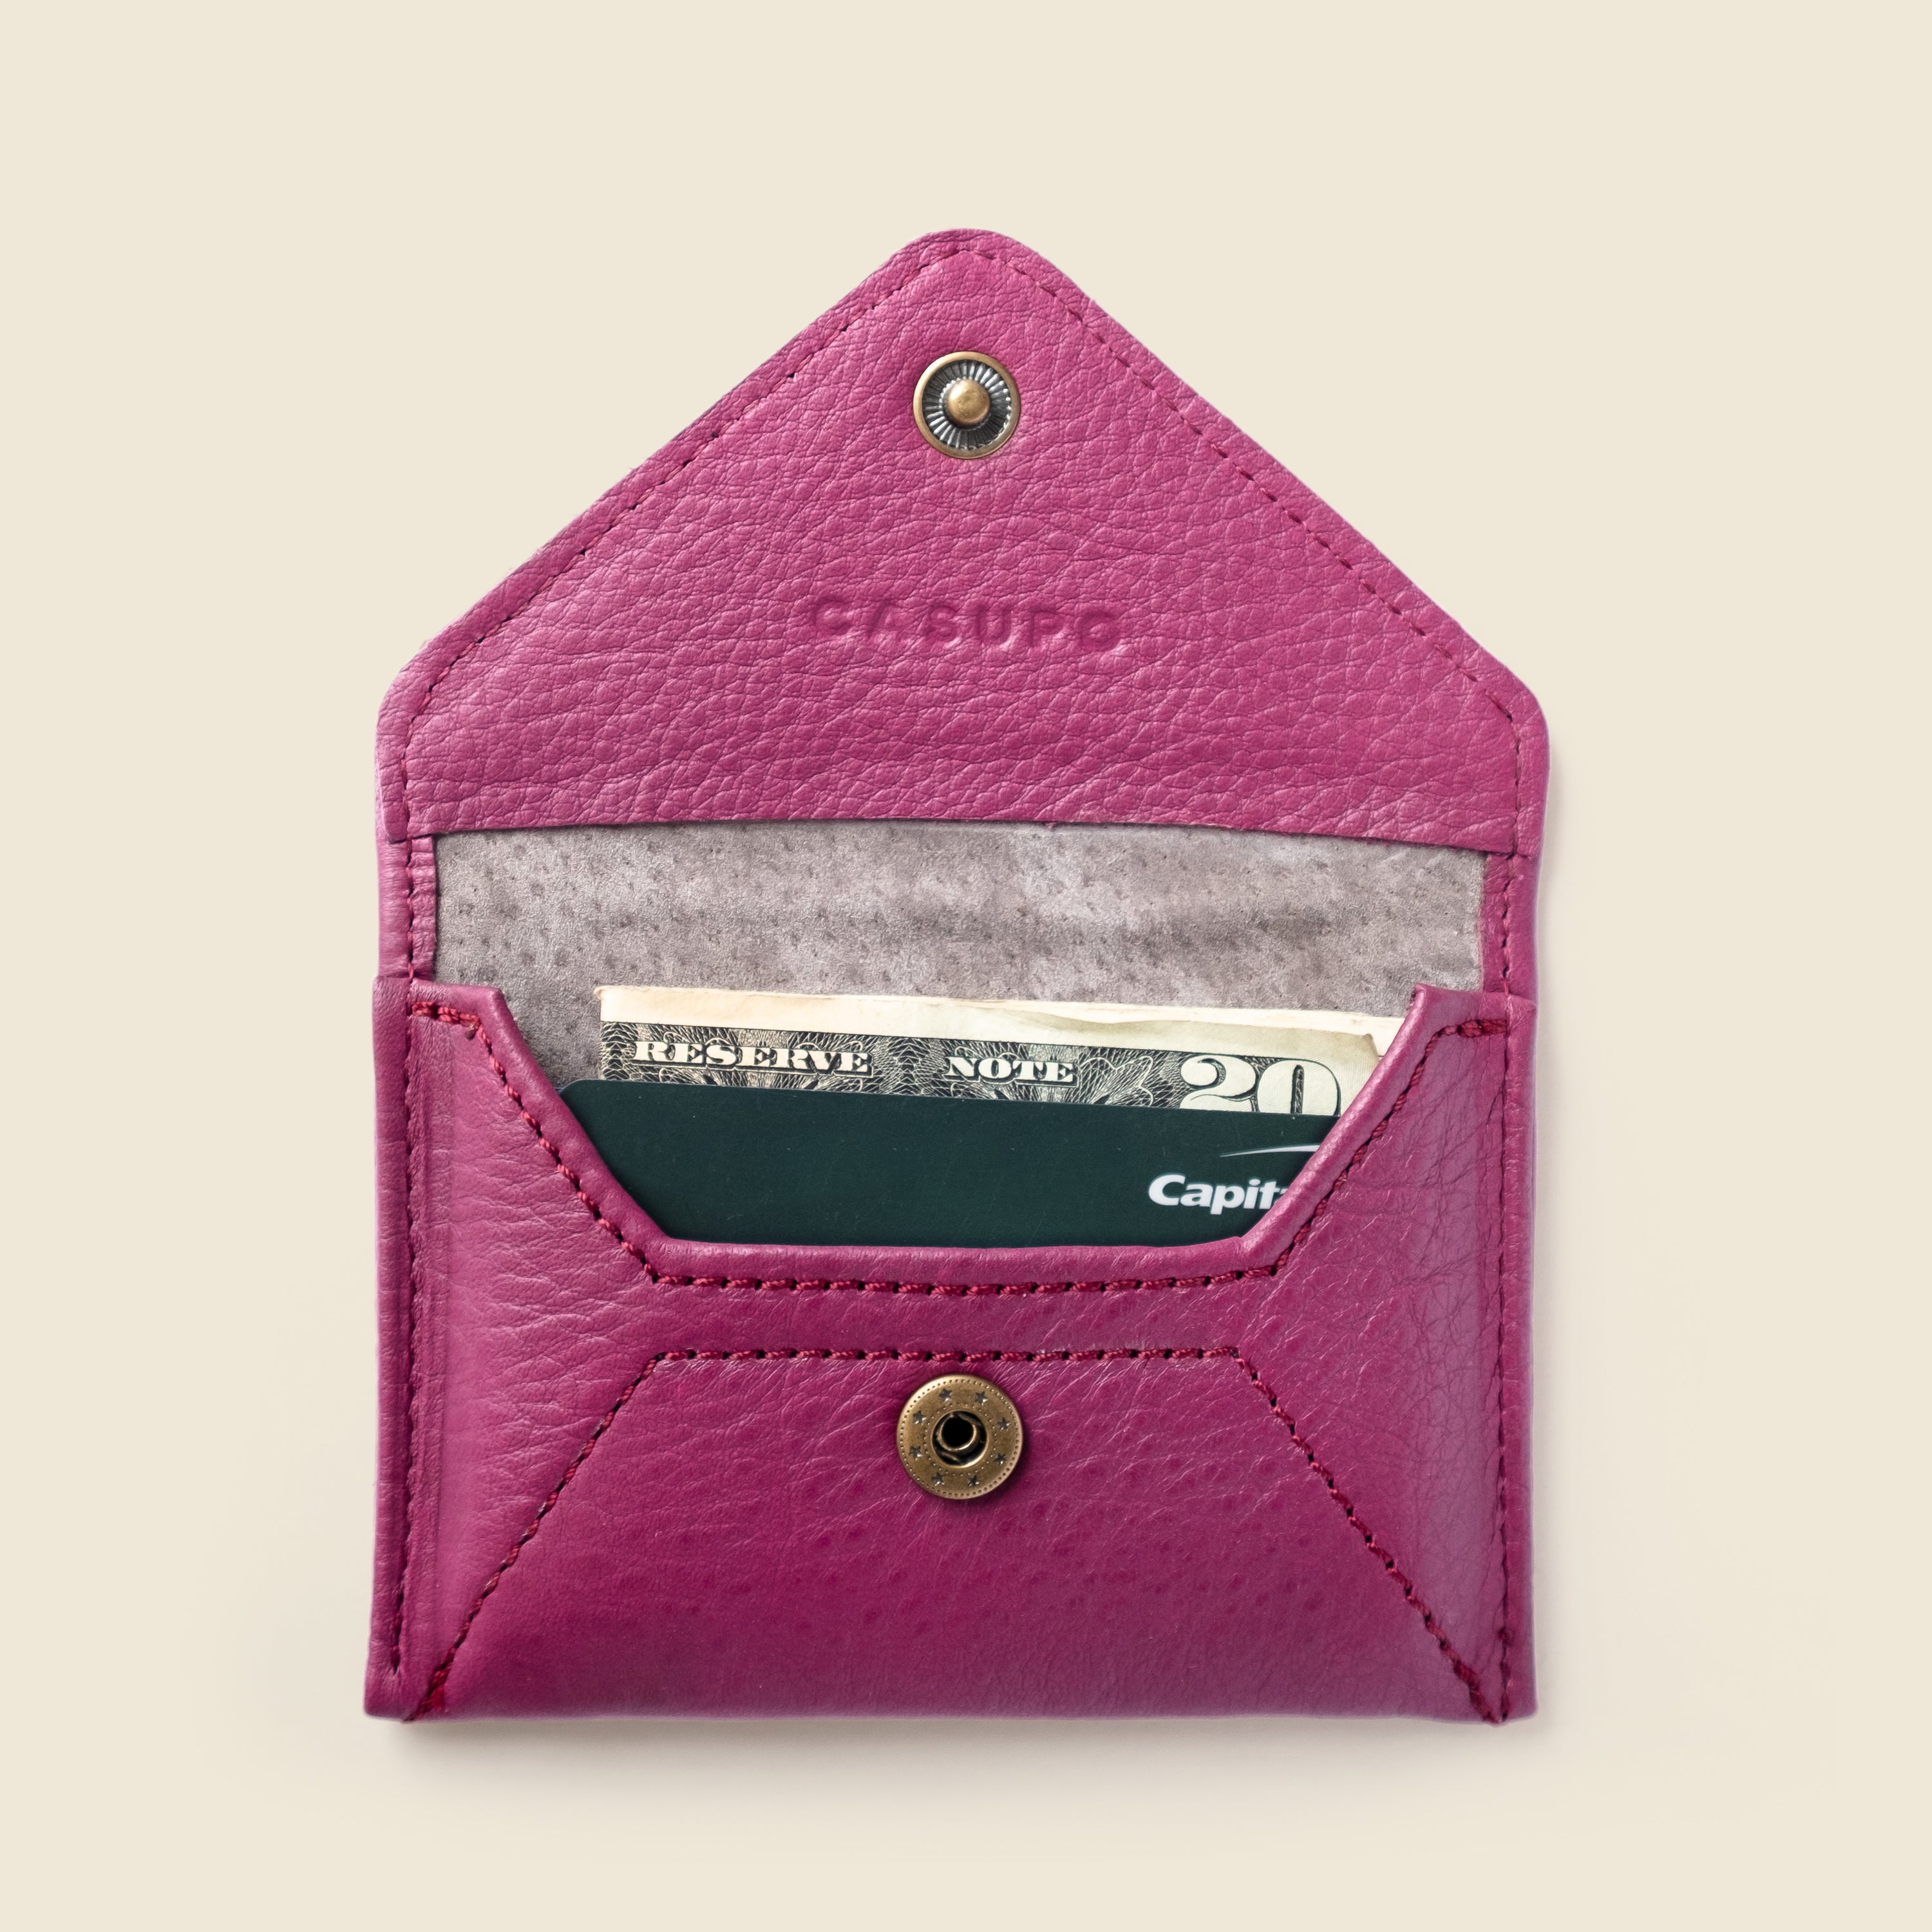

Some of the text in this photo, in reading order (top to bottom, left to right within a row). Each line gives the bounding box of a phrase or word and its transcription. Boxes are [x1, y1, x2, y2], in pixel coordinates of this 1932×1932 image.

[633, 1040, 1079, 1086] RESERVE NOTE
[1179, 1054, 1341, 1117] 20
[1148, 1173, 1288, 1215] Capit
